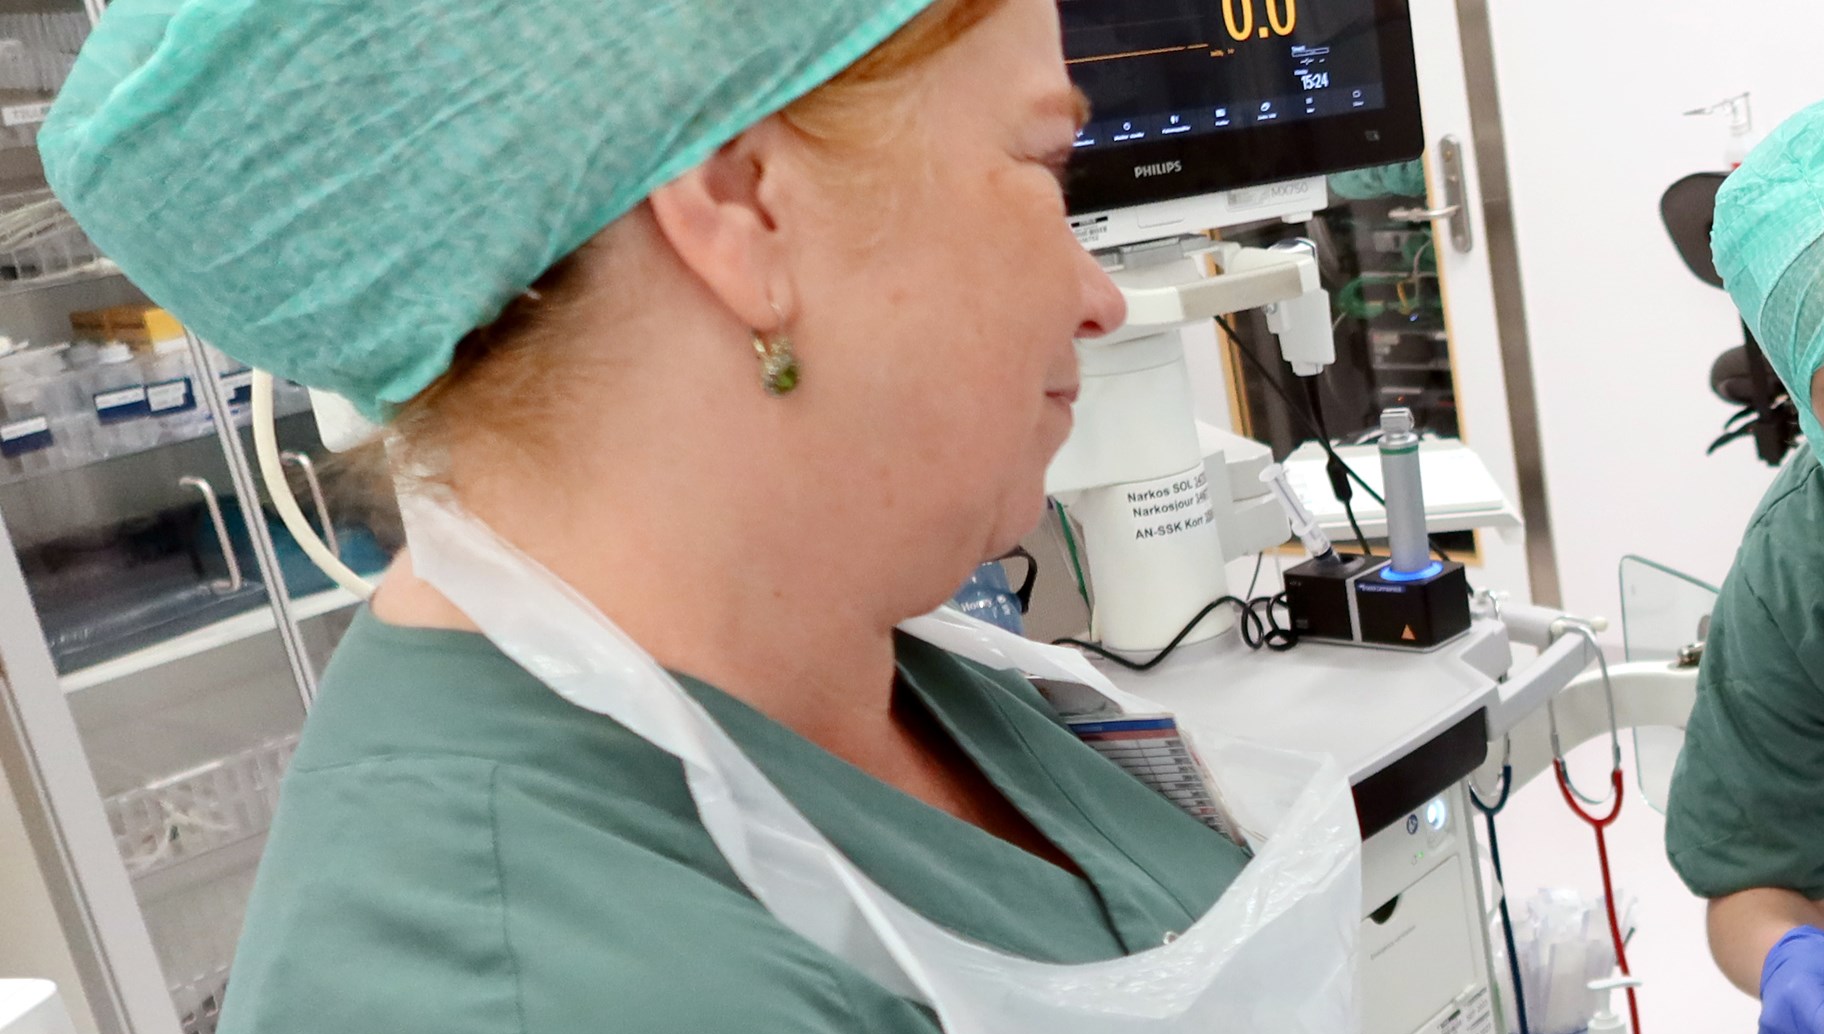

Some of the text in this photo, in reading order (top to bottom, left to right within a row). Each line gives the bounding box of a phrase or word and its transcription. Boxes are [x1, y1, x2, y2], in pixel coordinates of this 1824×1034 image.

[1134, 160, 1182, 178] PHILIPS
[1270, 183, 1309, 198] MX750
[1127, 488, 1170, 503] Narkos
[1172, 480, 1194, 494] SOL
[1132, 496, 1194, 518] Narkosjour
[1135, 521, 1183, 540] AN-SSK
